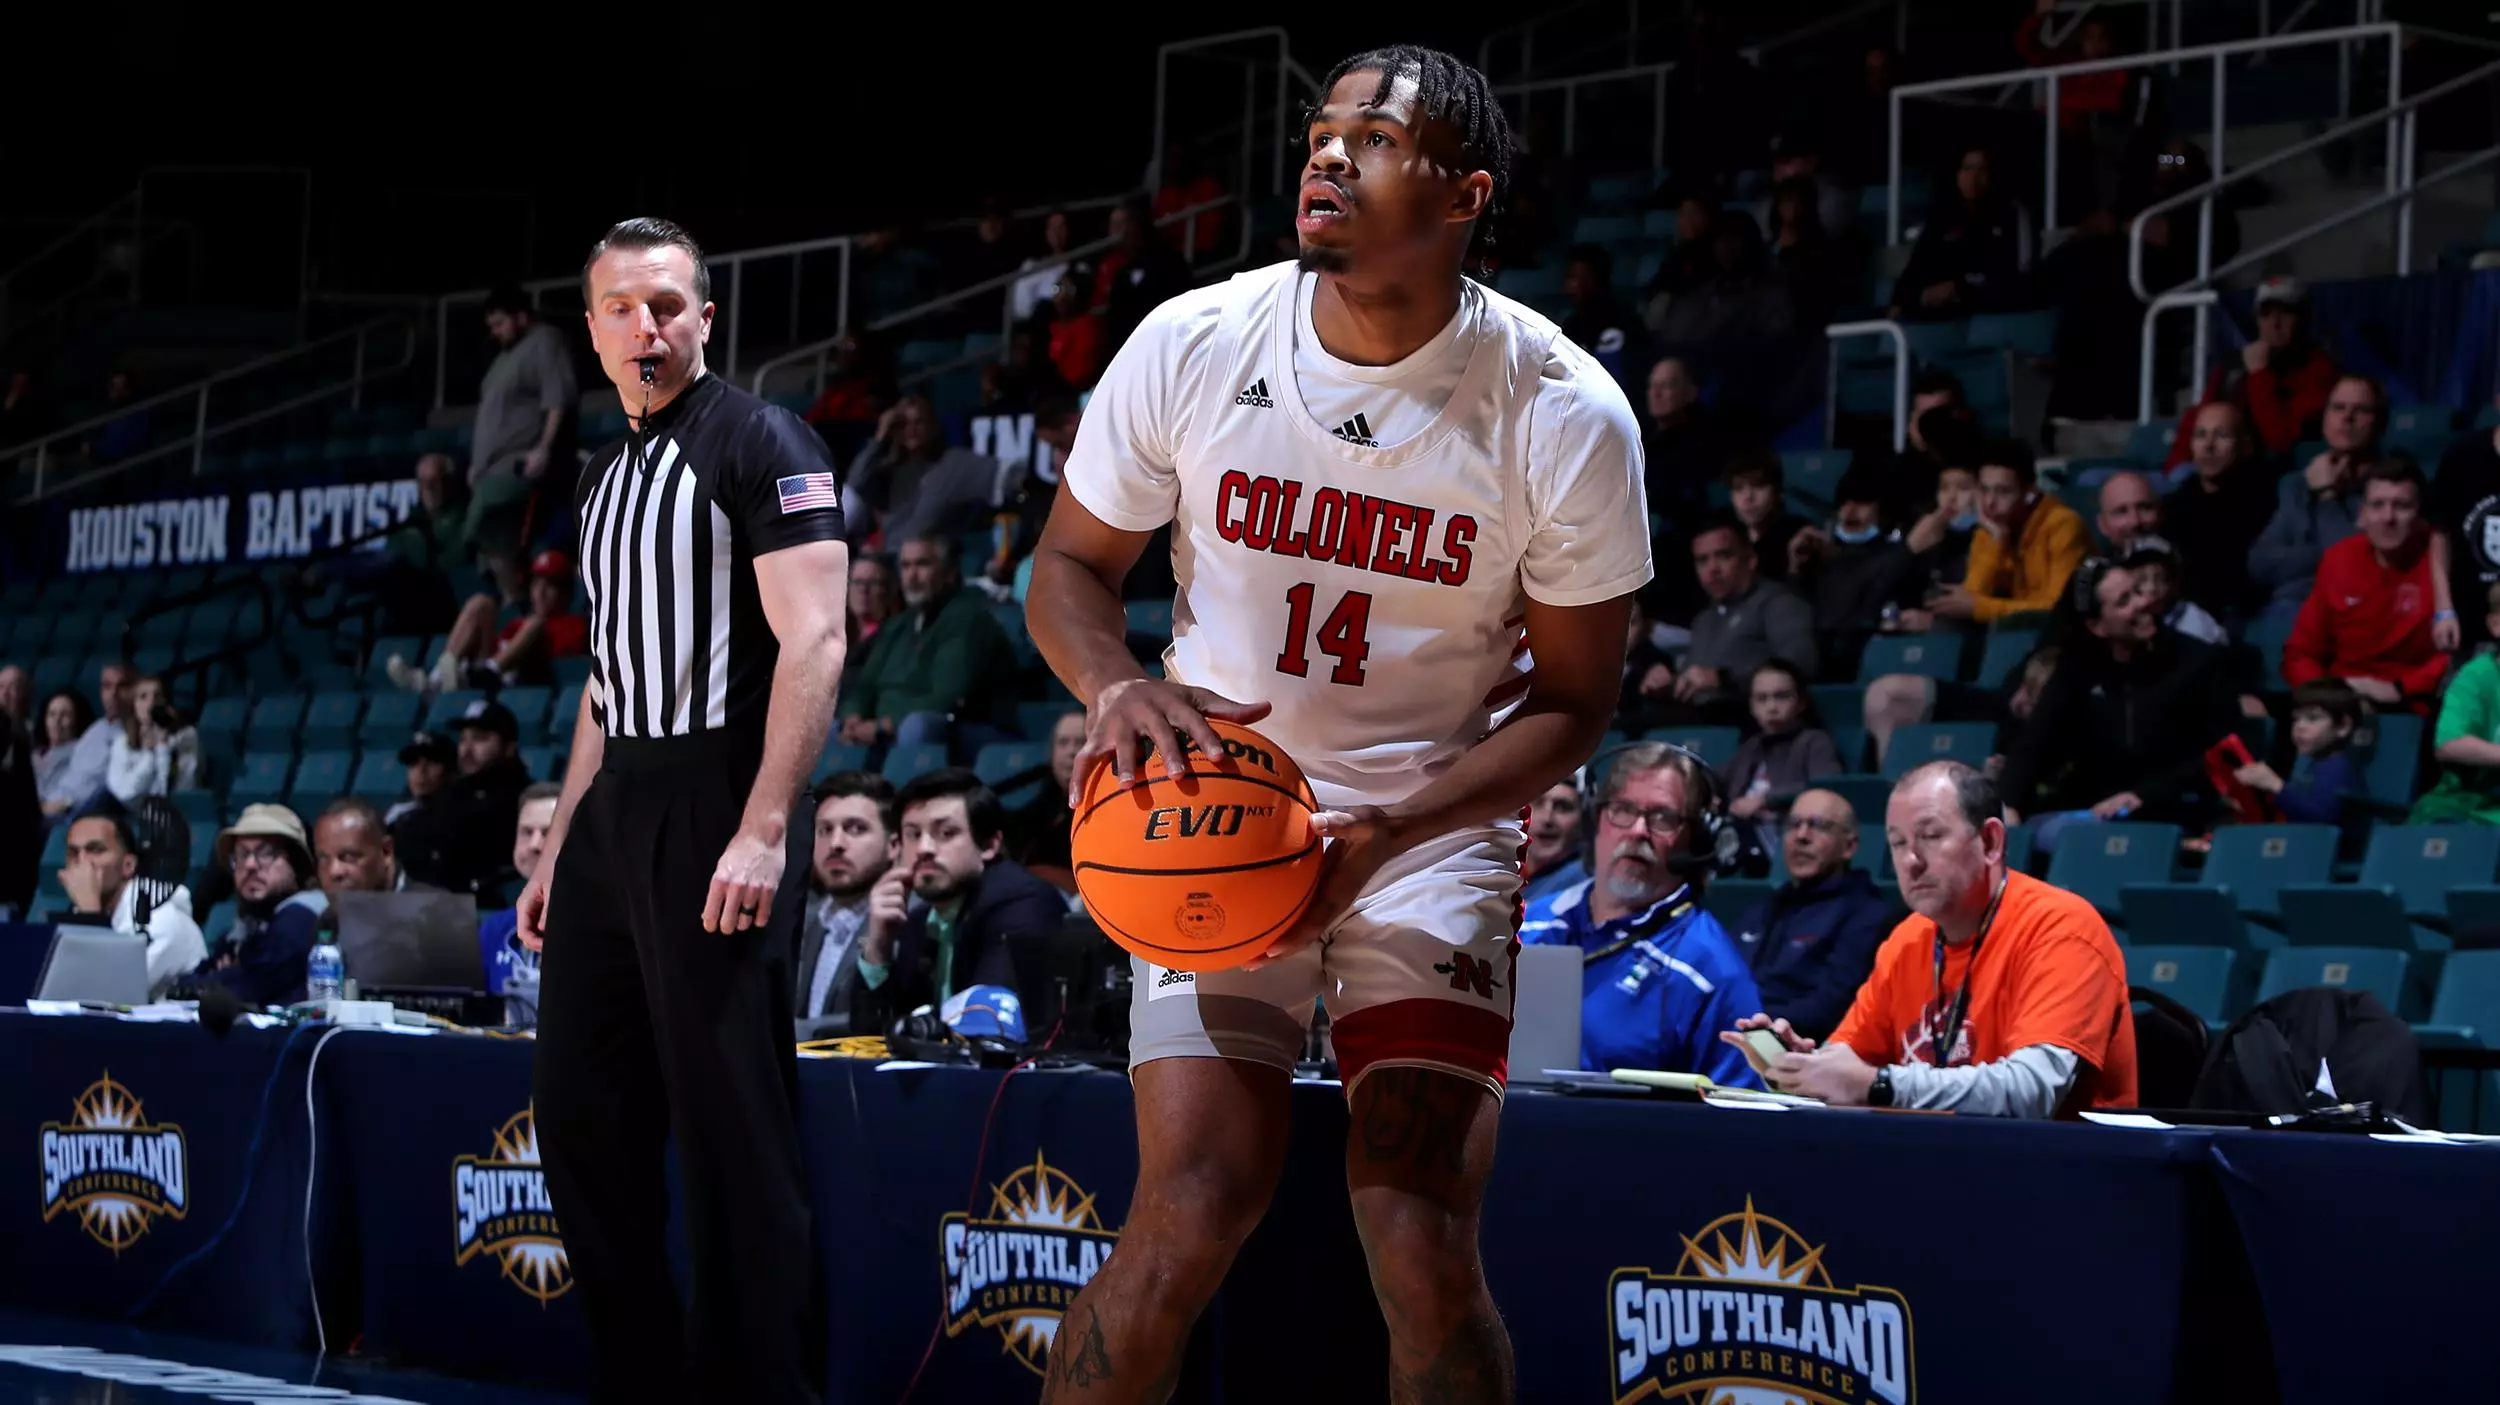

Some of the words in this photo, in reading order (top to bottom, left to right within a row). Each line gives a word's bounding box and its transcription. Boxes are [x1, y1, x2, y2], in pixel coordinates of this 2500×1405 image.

[1235, 393, 1273, 408] adidas
[66, 496, 230, 572] HOUSTON
[246, 479, 419, 559] BAPTIST
[1216, 469, 1479, 587] COLONELS
[1275, 582, 1373, 687] 14
[1144, 804, 1245, 841] EVO
[1246, 805, 1277, 818] NXT
[1158, 972, 1194, 988] adidas
[43, 1130, 184, 1208] SOUTHLAND
[67, 1173, 160, 1200] CONFERENCE
[1615, 1280, 1906, 1405] SOUTHLAND
[1665, 1350, 1855, 1396] CONFERENCE
